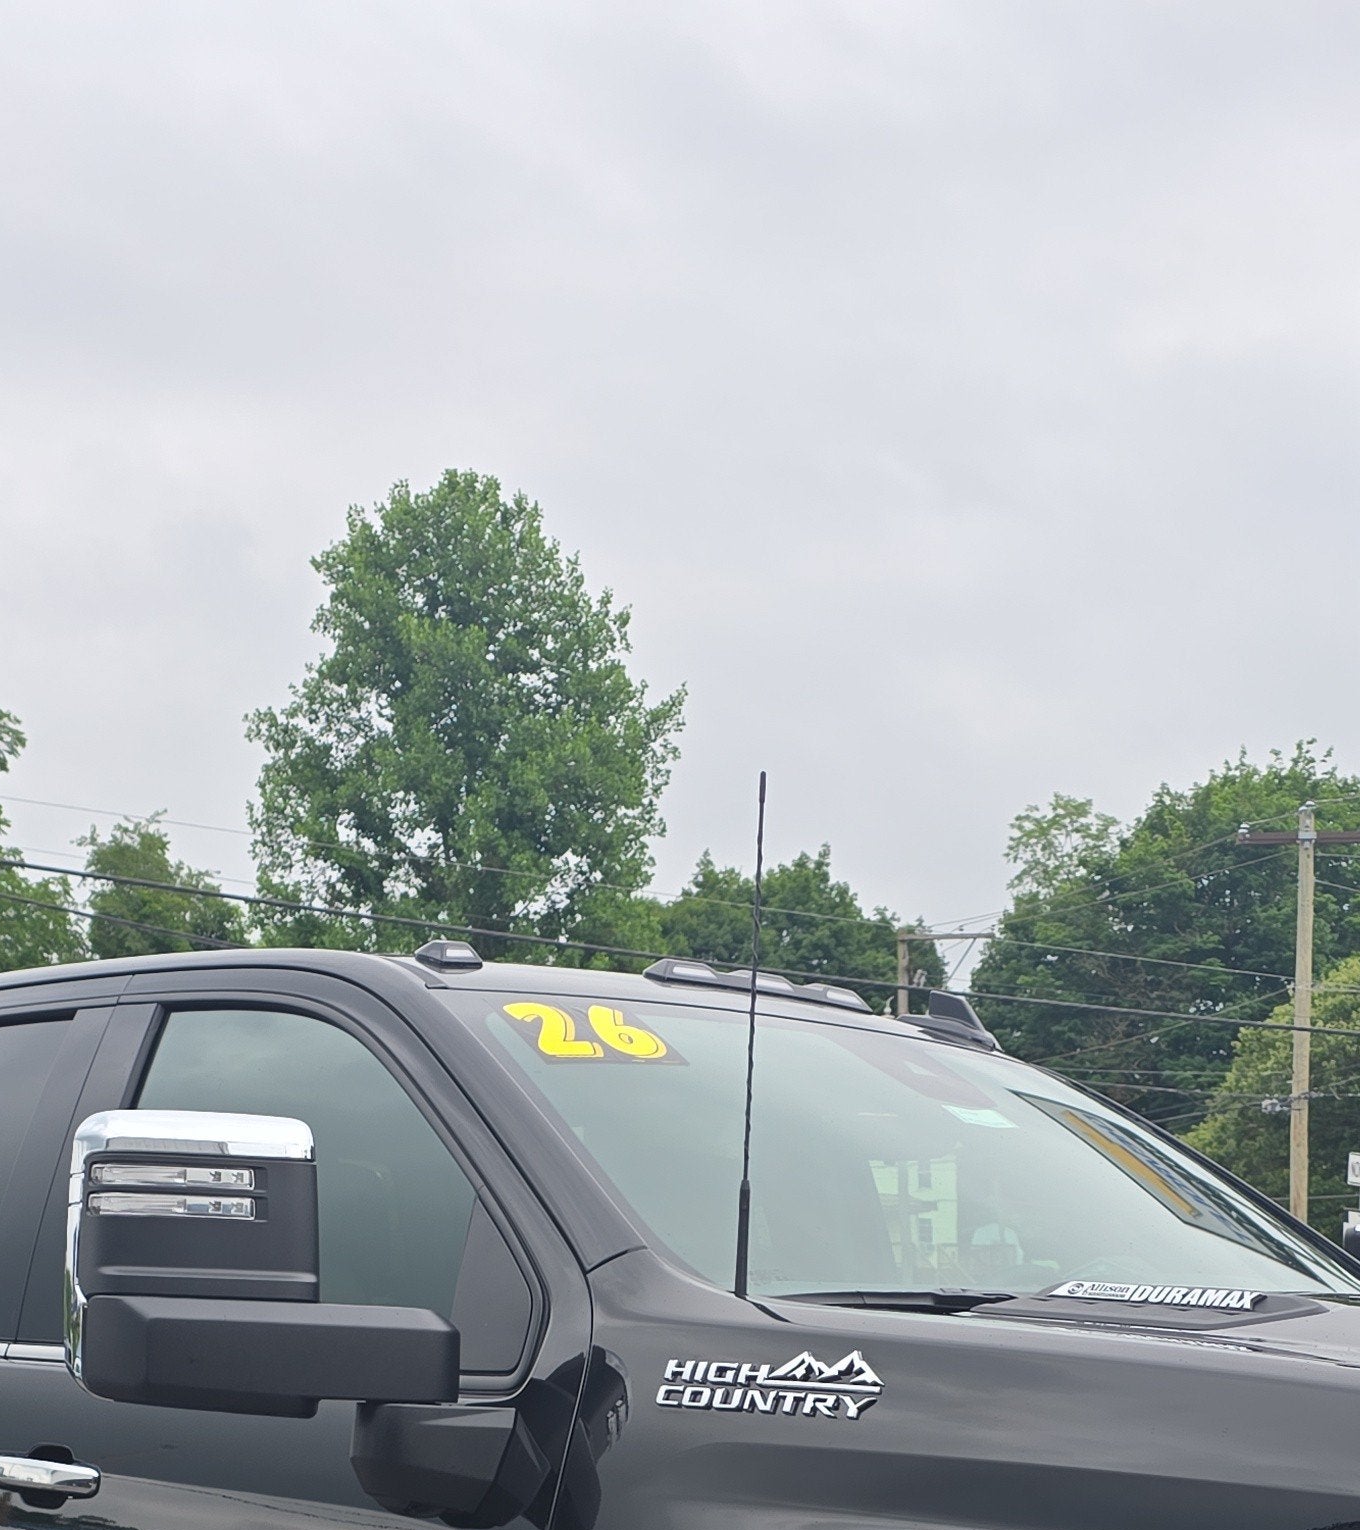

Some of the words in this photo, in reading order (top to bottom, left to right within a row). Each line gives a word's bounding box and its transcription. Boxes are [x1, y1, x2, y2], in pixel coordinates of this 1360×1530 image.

[503, 1003, 667, 1058] 26
[1130, 1285, 1264, 1310] DURAMAX
[663, 1359, 771, 1386] HIGH
[655, 1384, 878, 1419] COUNTRY
